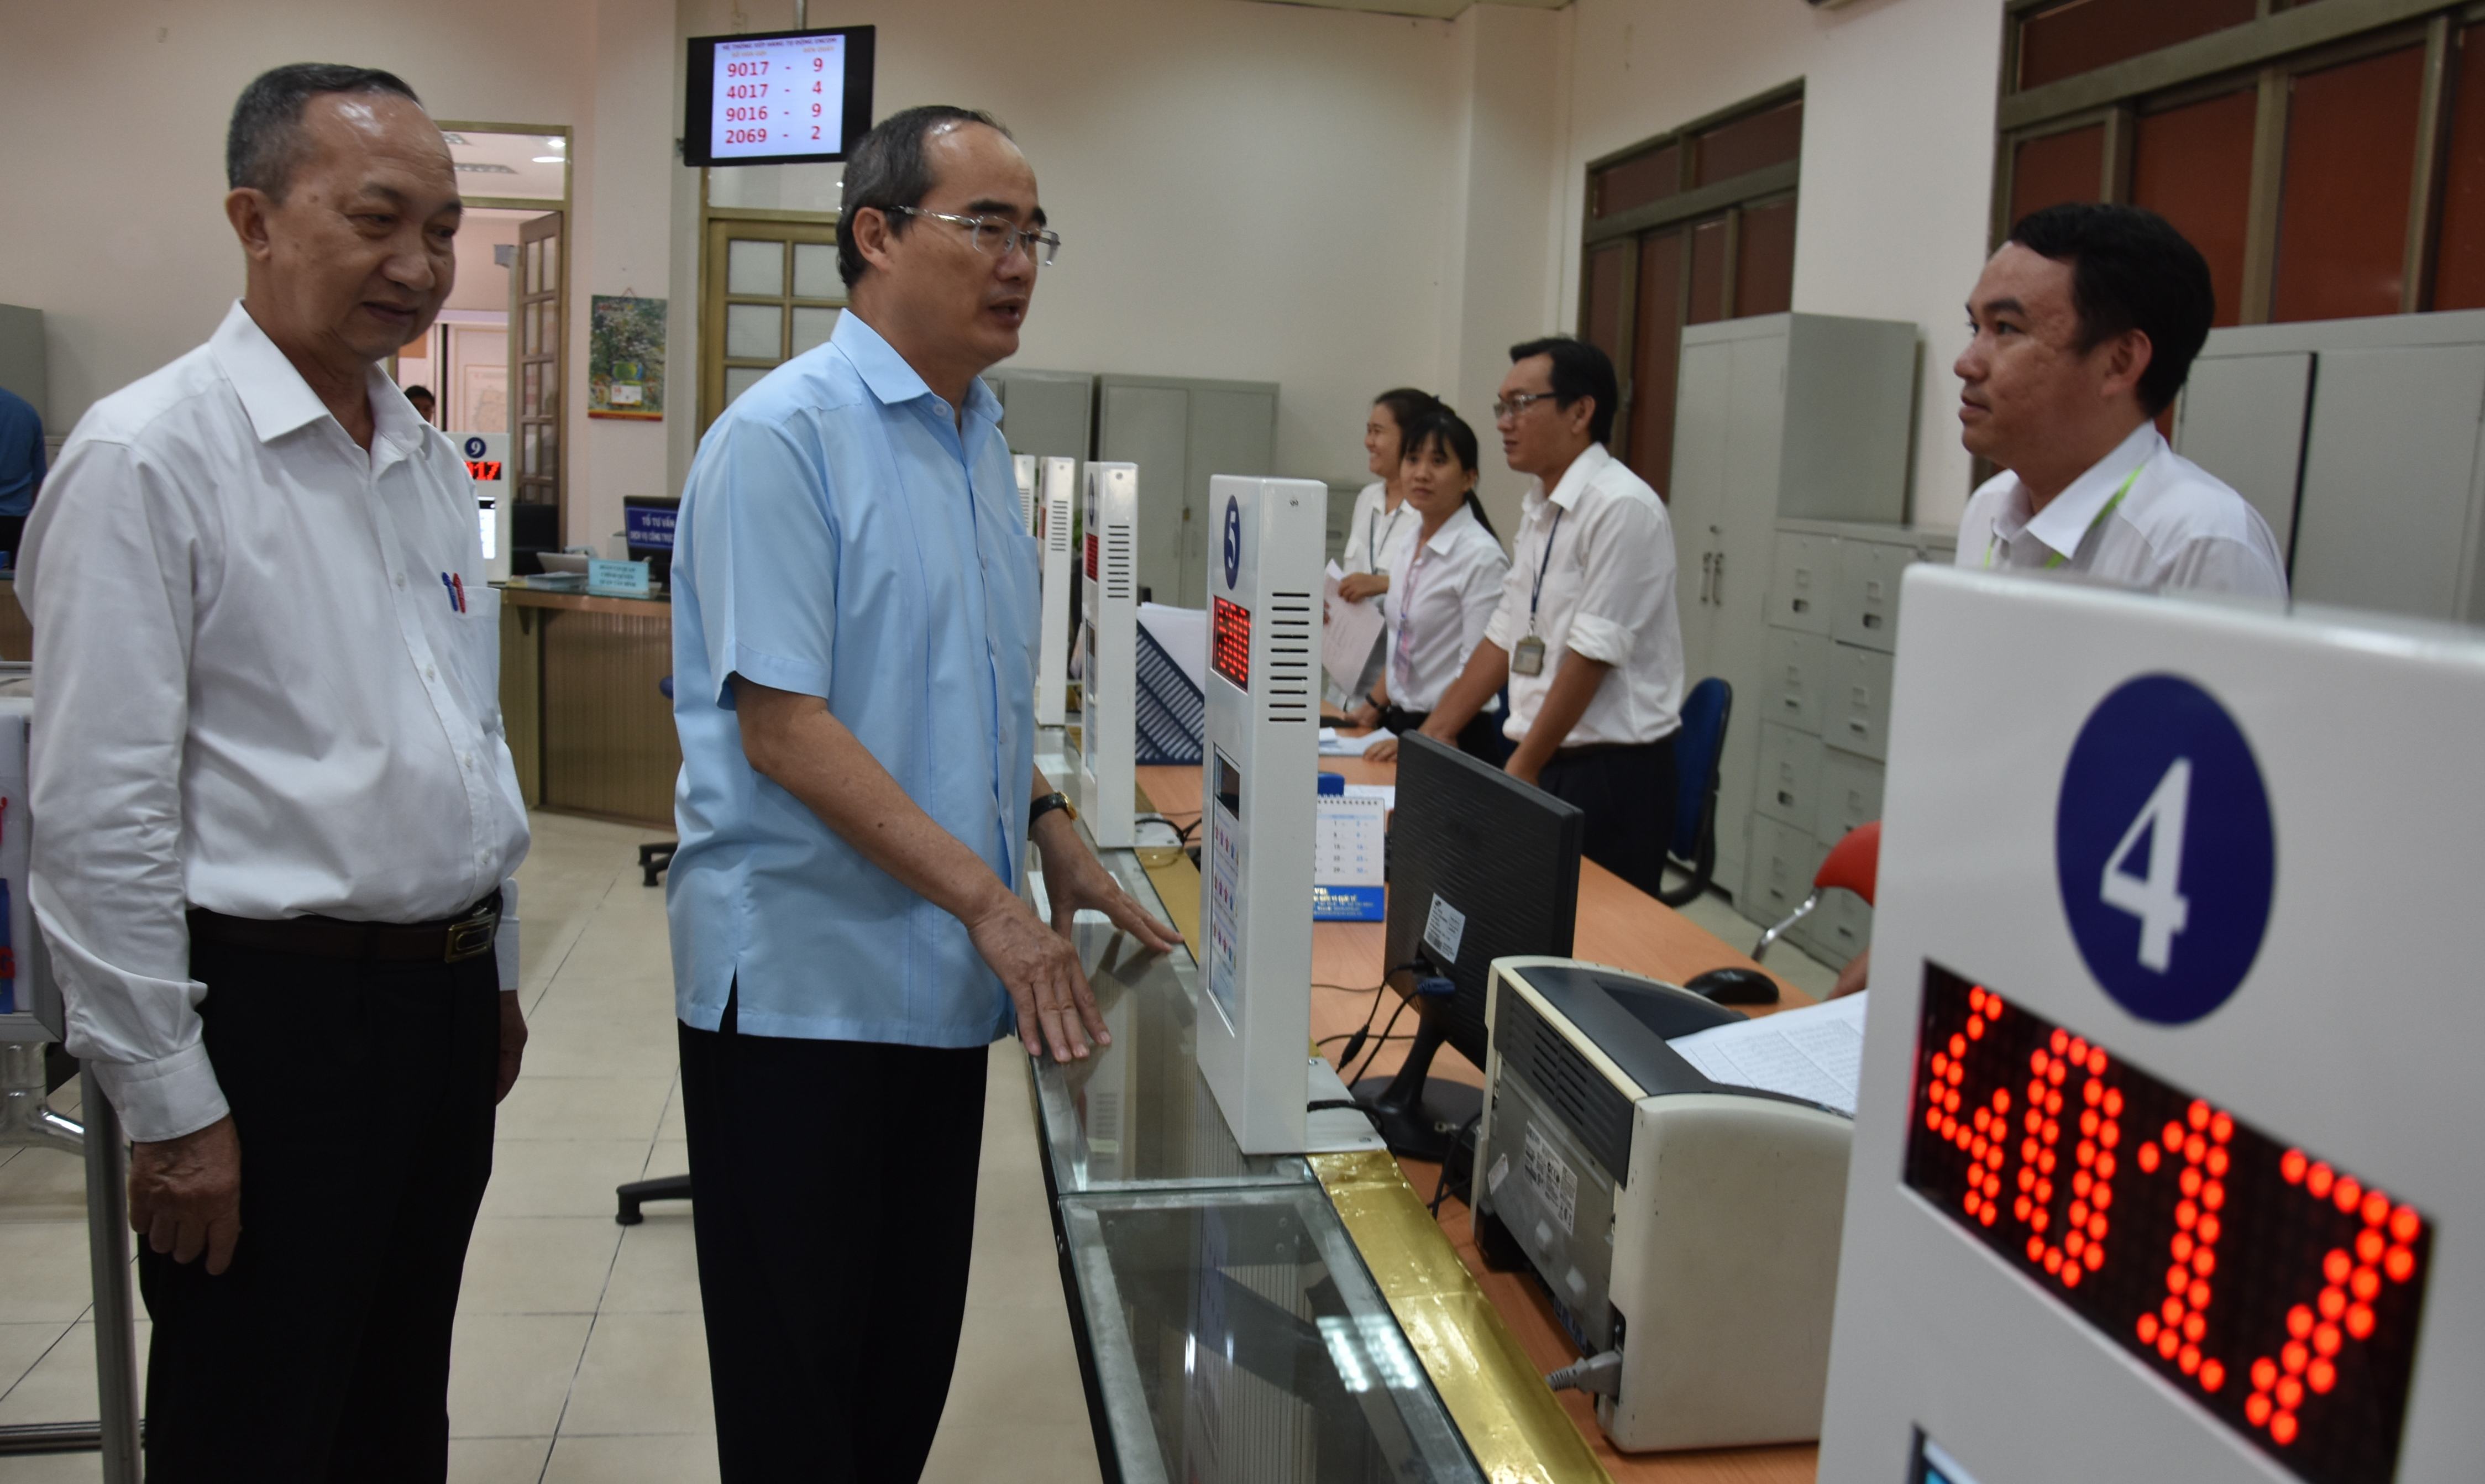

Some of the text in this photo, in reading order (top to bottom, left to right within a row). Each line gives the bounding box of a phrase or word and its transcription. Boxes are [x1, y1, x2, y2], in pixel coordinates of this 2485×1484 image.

[727, 61, 769, 77] 9017
[814, 57, 823, 72] 9
[727, 83, 768, 99] 4017
[812, 81, 822, 95] 4
[726, 106, 768, 122] 9016
[812, 103, 821, 117] 9
[725, 128, 767, 144] 2069
[811, 125, 820, 140] 2
[471, 441, 481, 455] 9
[1229, 510, 1236, 569] 5
[2101, 756, 2192, 974] 4
[1925, 984, 2423, 1446] 4017
